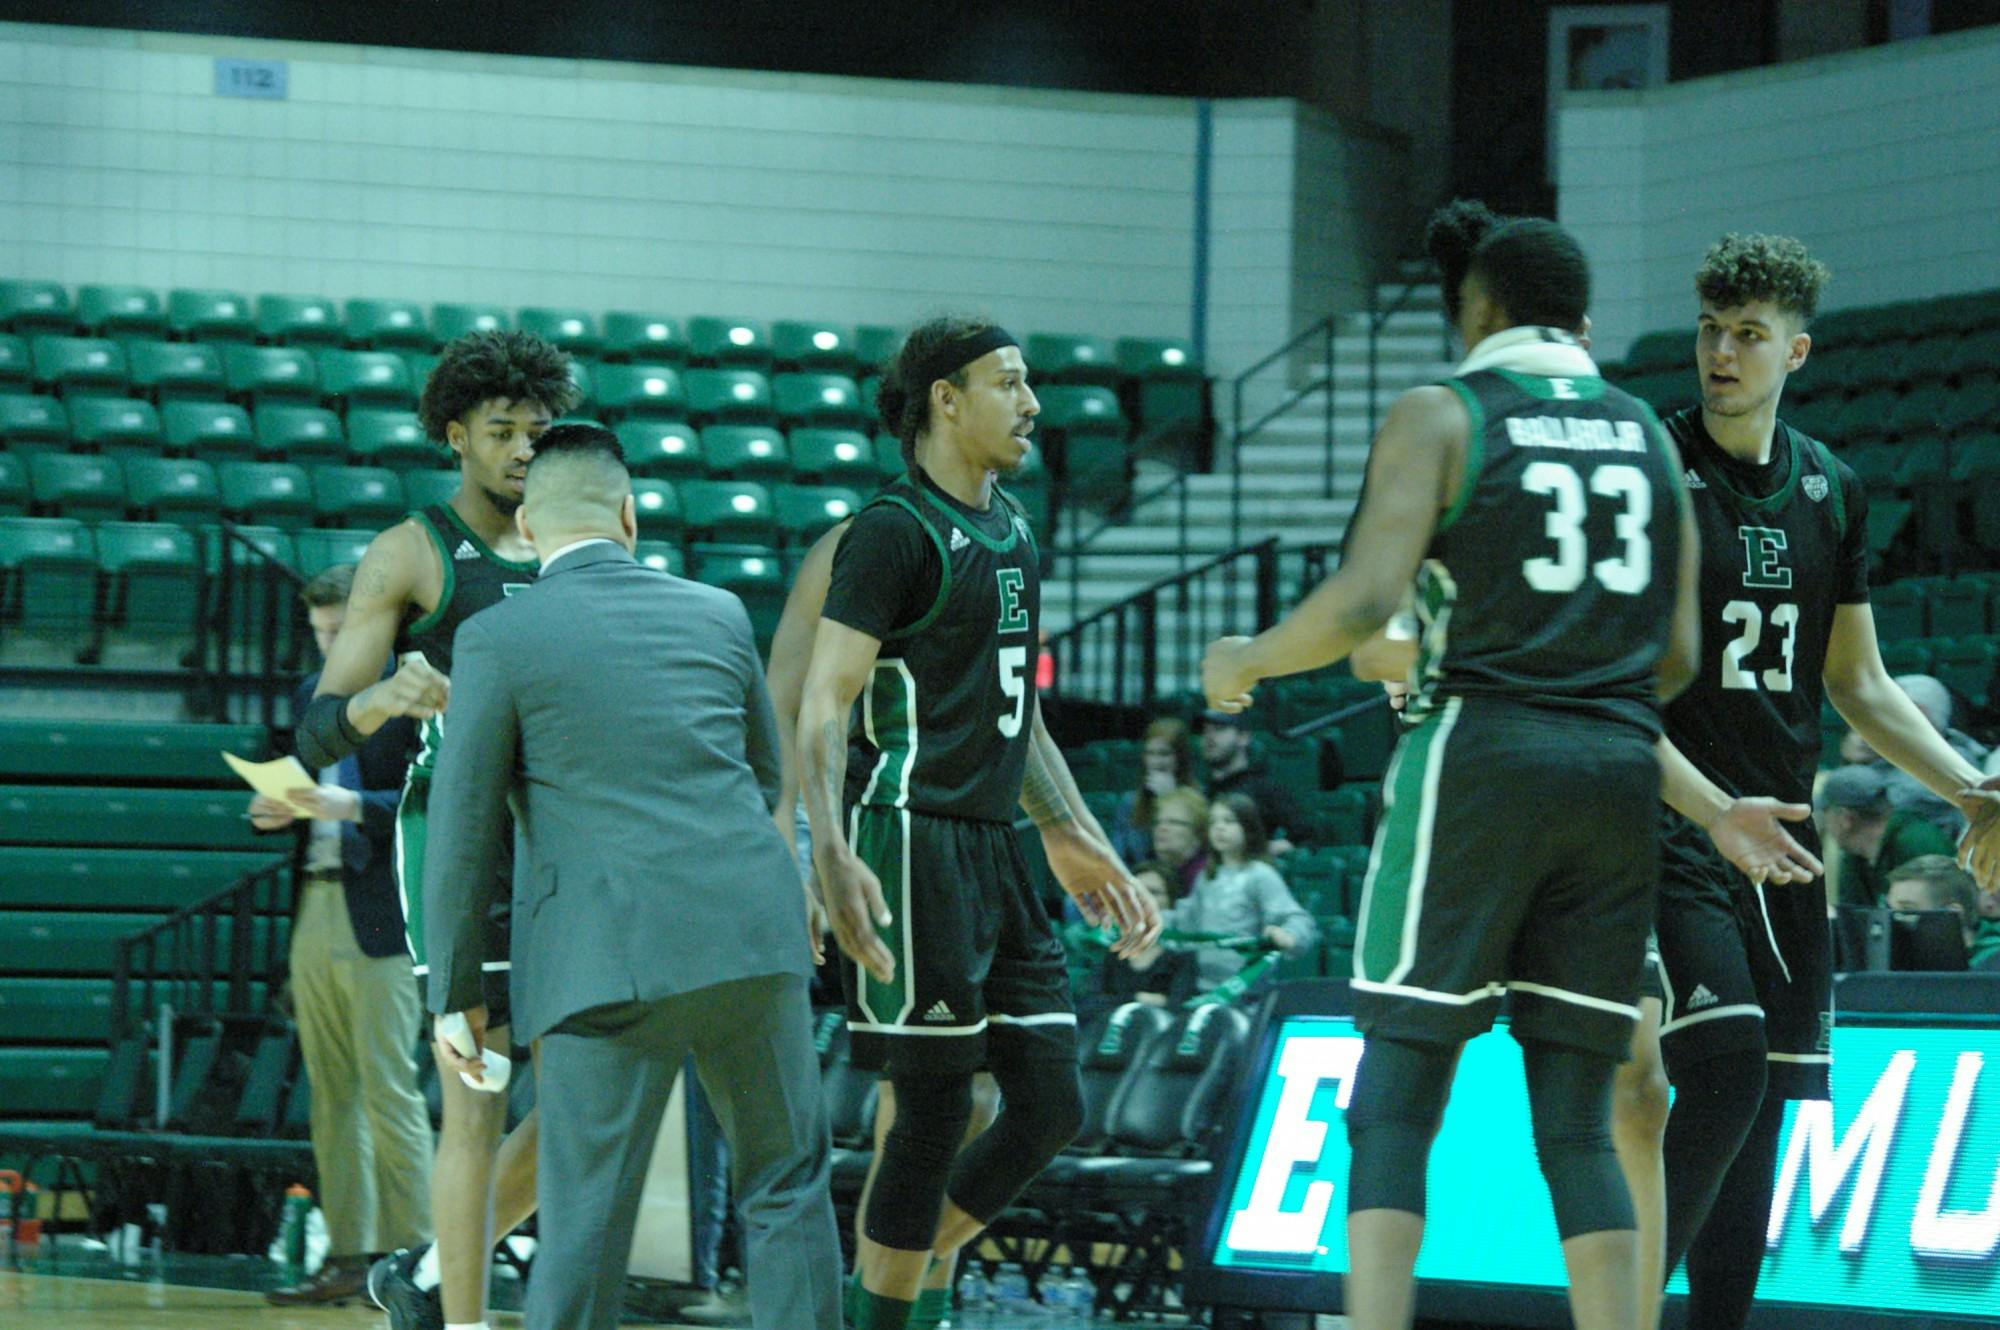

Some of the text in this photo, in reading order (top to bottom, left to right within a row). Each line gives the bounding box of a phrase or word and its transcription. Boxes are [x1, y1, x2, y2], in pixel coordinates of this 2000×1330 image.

[230, 68, 274, 89] 112
[1548, 378, 1580, 399] E
[1520, 461, 1652, 595] 33
[1738, 525, 1793, 589] E
[996, 567, 1029, 634] E
[1721, 600, 1799, 692] 23
[996, 646, 1027, 738] 5
[1226, 1036, 1365, 1254] E
